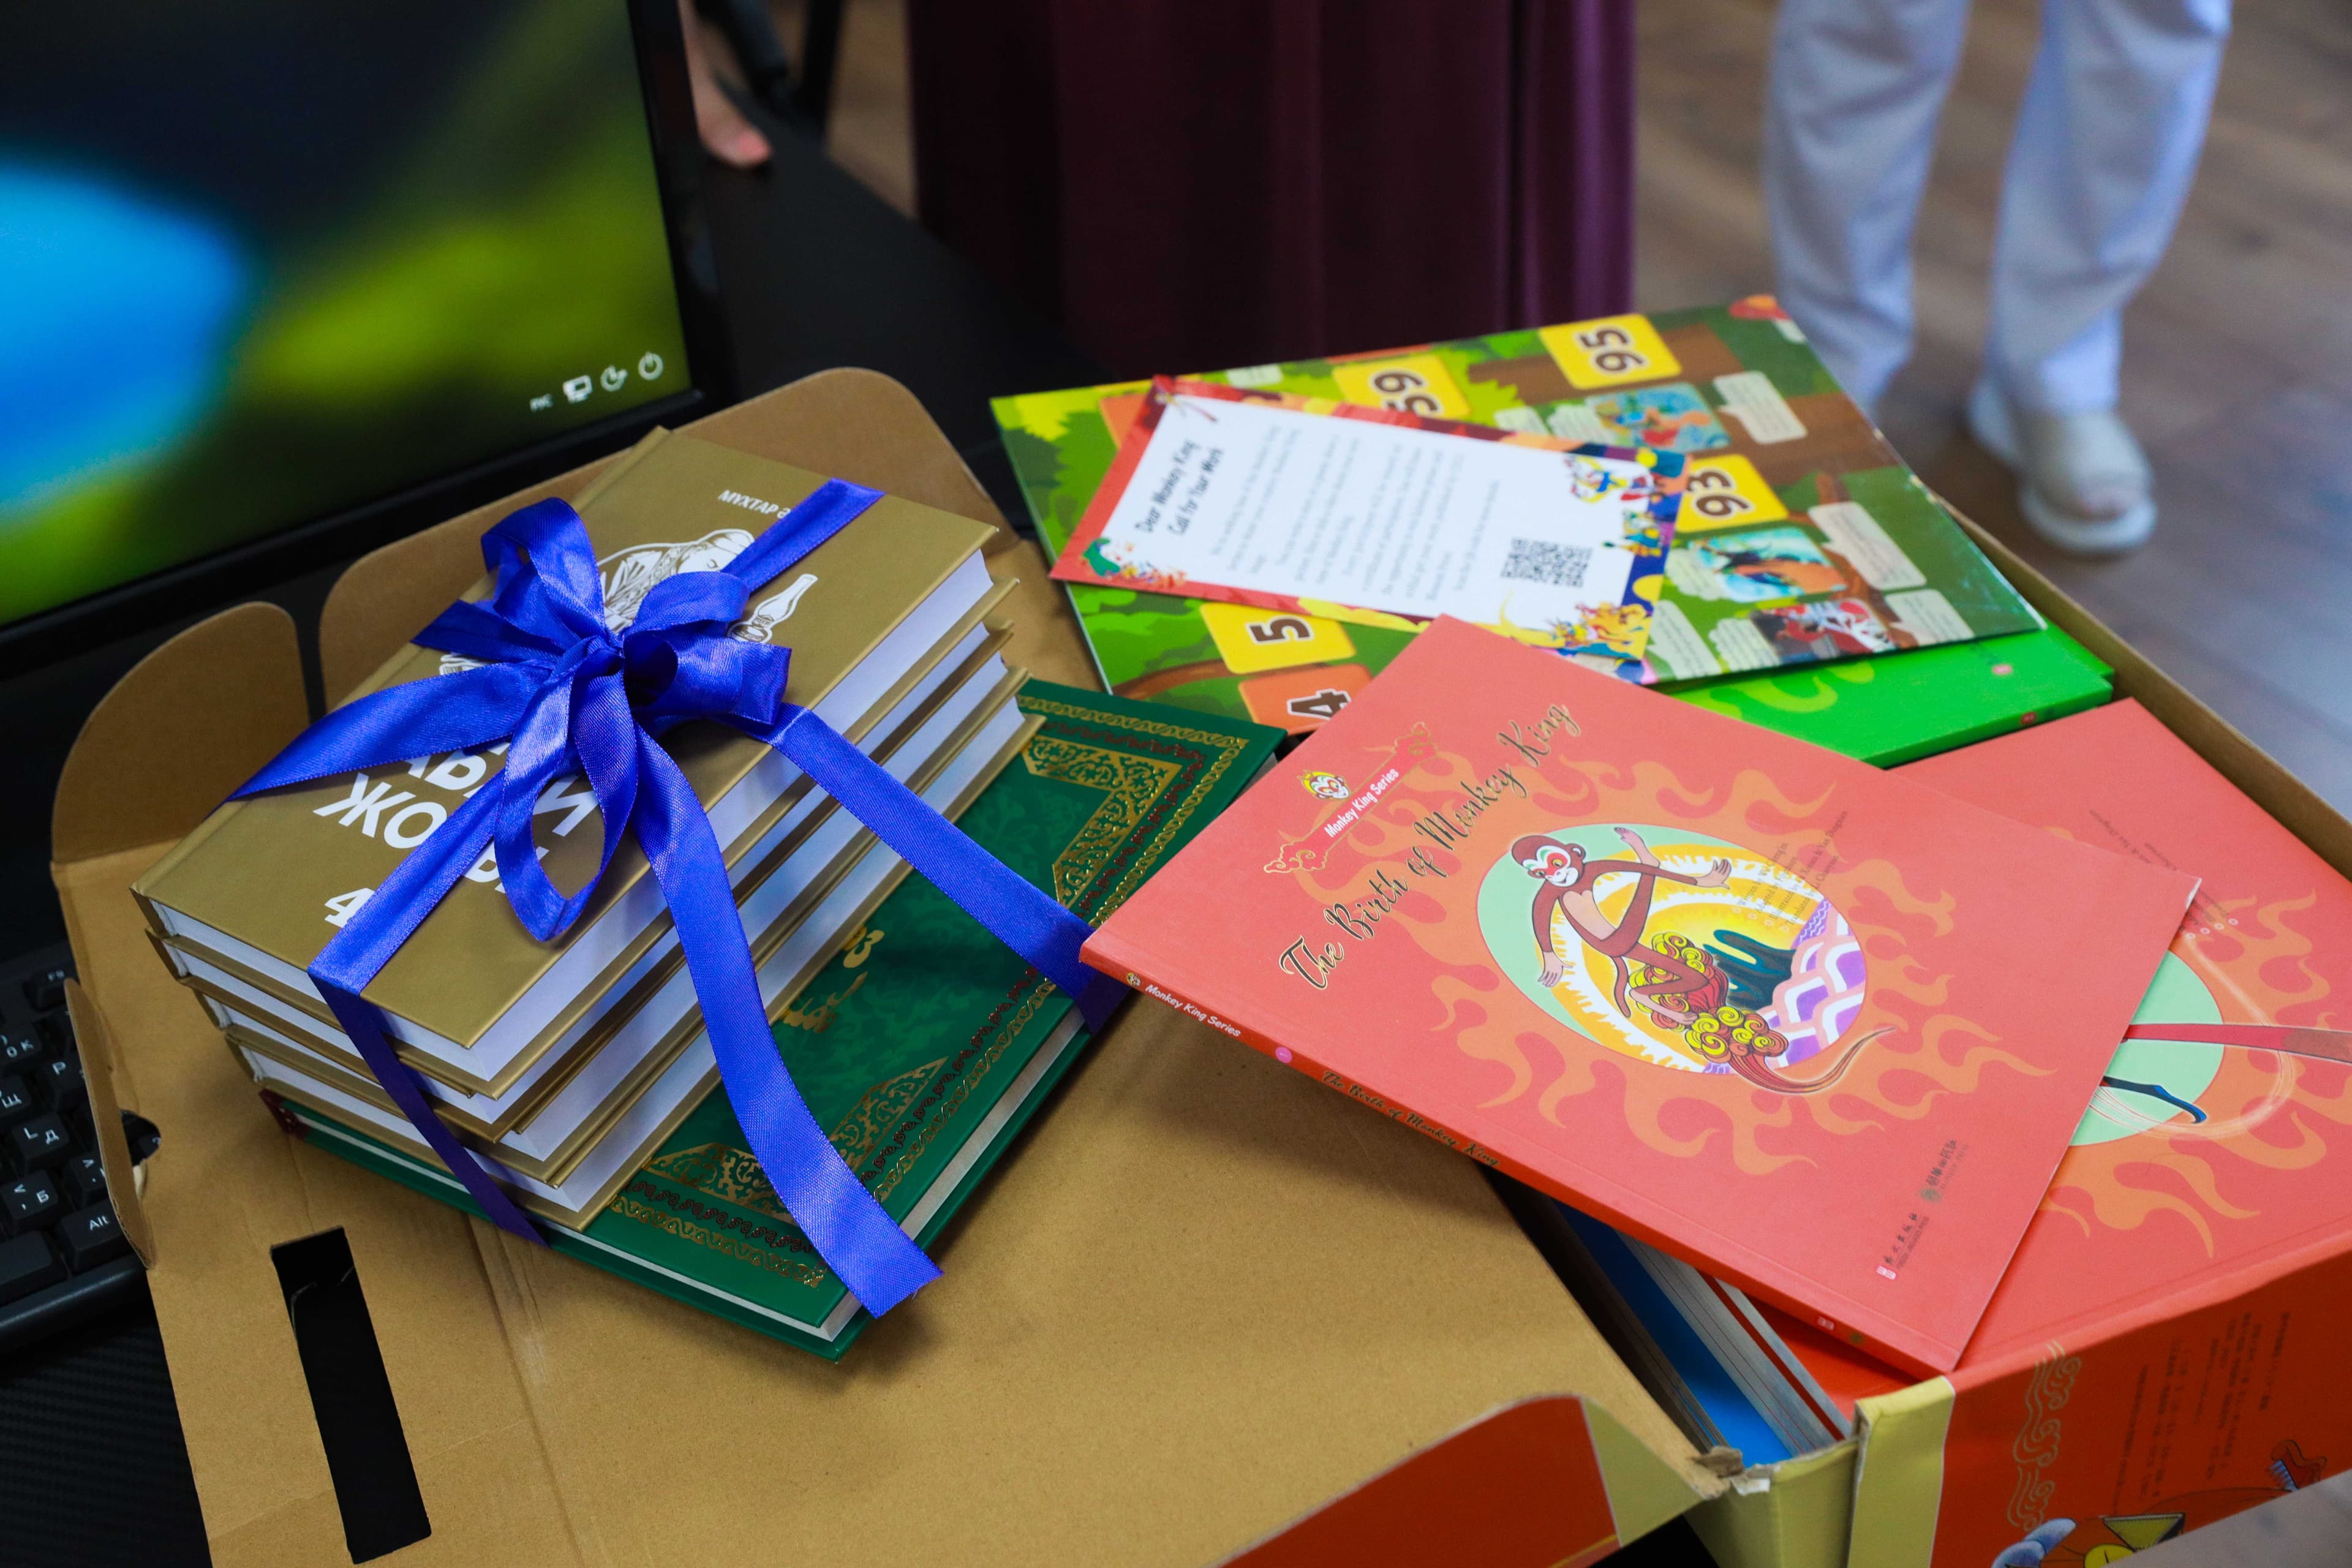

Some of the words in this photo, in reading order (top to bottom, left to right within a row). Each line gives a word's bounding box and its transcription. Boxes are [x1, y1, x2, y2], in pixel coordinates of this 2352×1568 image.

[1578, 327, 1648, 375] 95
[1152, 467, 1185, 504] Monkey
[1174, 440, 1202, 464] King
[1247, 616, 1313, 643] 5
[1288, 690, 1351, 719] 4
[1497, 704, 1581, 767] King
[1324, 807, 1359, 837] Monkey
[1352, 791, 1378, 812] King
[1370, 768, 1400, 796] Series
[1413, 763, 1529, 852] Monkey
[1406, 844, 1449, 878] of
[1323, 869, 1409, 941] Birth
[1279, 935, 1344, 990] The
[1145, 983, 1183, 1011] Monkey
[1183, 1001, 1207, 1022] King
[1207, 1016, 1241, 1038] Series
[1322, 1069, 1345, 1090] The
[1349, 1083, 1385, 1110] Birth
[1387, 1106, 1403, 1120] of
[1406, 1112, 1458, 1147] Monkey
[1463, 1141, 1500, 1167] King
[36, 1189, 49, 1204] Б
[89, 1215, 109, 1231] Alt
